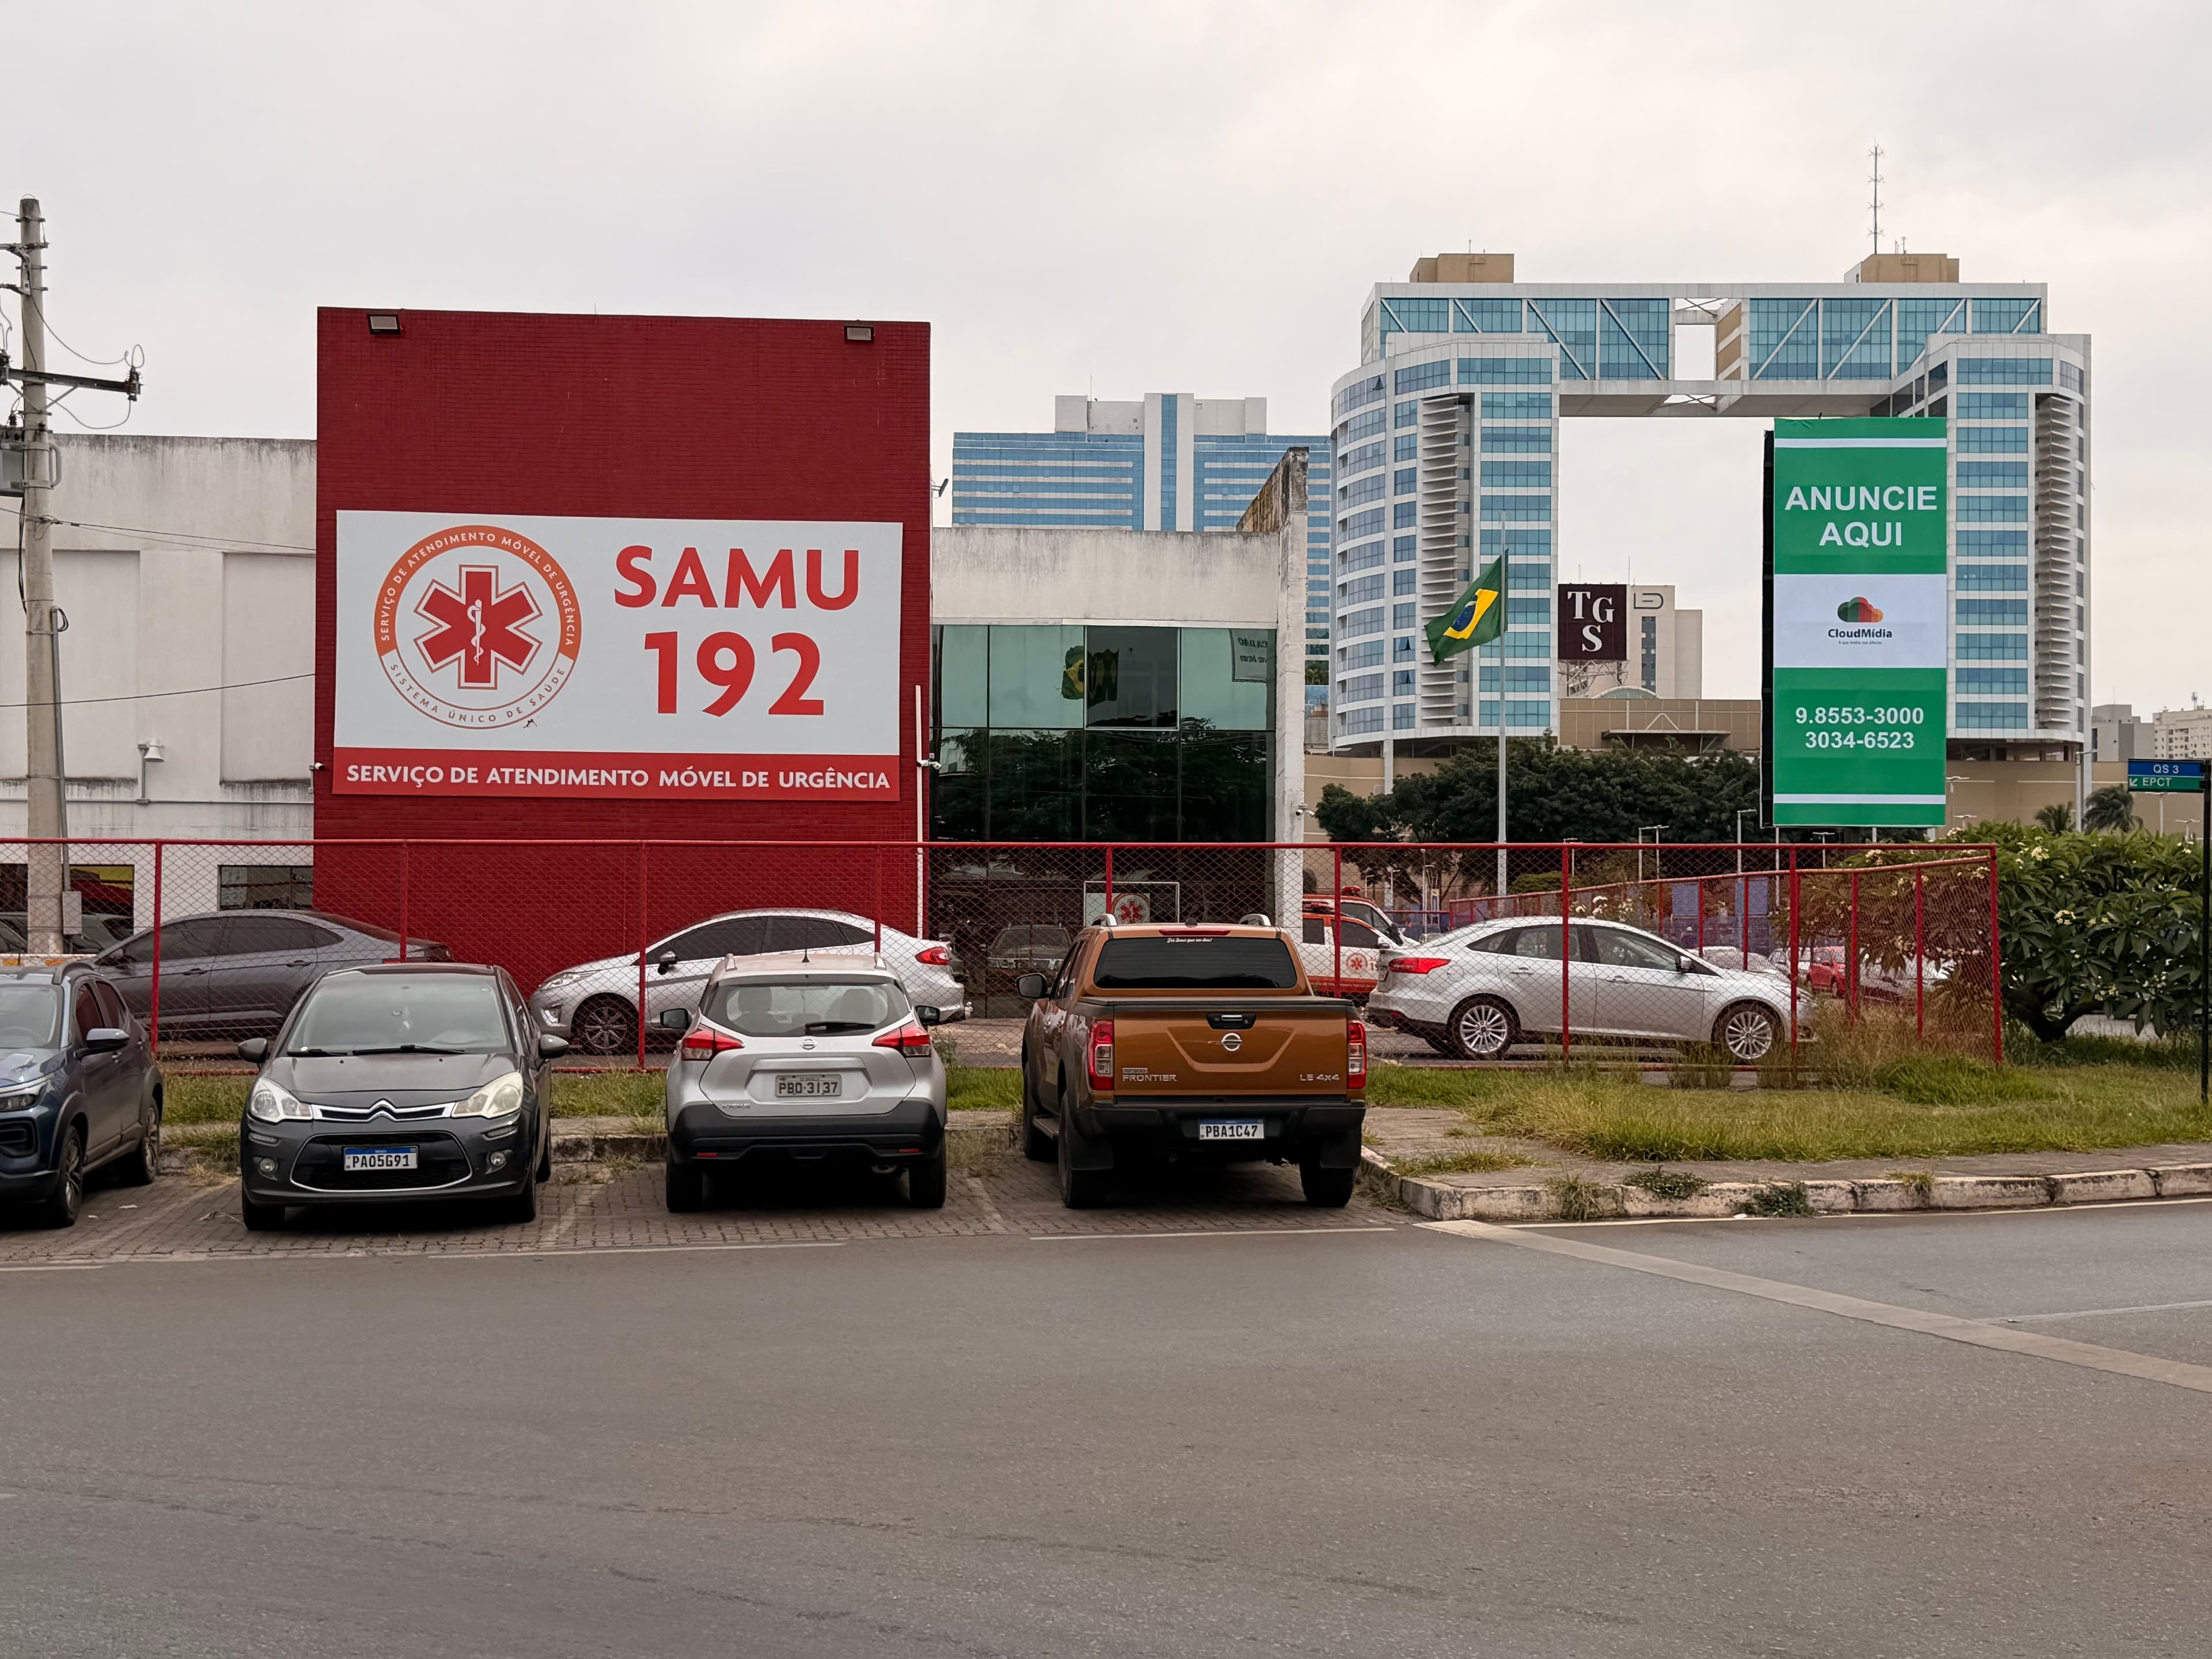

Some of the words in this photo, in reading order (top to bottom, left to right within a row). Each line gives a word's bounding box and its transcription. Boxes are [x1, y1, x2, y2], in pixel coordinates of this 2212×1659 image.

[1785, 486, 1937, 510] ANUNCIE
[1820, 521, 1902, 548] AQUI
[381, 588, 396, 641] SERVIÇO
[393, 568, 407, 584] DE
[407, 532, 495, 568] ATENDIMENTO
[501, 536, 541, 565] MÓVEL
[543, 564, 558, 580] DE
[555, 581, 575, 646] URGÊNCIA
[614, 545, 859, 611] SAMU
[1828, 628, 1892, 638] CloudMídia
[644, 631, 824, 717] 192
[391, 664, 438, 713] SISTEMA
[448, 710, 496, 723] ÚNICO
[506, 707, 522, 718] DE
[529, 668, 565, 706] SAÚDE
[1795, 707, 1925, 725] 9.8553-3000
[1805, 732, 1915, 749] 3034-6523
[346, 765, 444, 787] SERVIÇO
[450, 767, 479, 783] DE
[486, 768, 649, 786] ATENDIMENTO
[659, 766, 736, 787] MÓVEL
[742, 771, 769, 787] DE
[779, 767, 891, 789] URGÊNCIA
[2153, 764, 2169, 774] QS
[2172, 765, 2179, 774] 3
[2142, 778, 2172, 787] EPCT
[1205, 1125, 1257, 1138] PBA1C47
